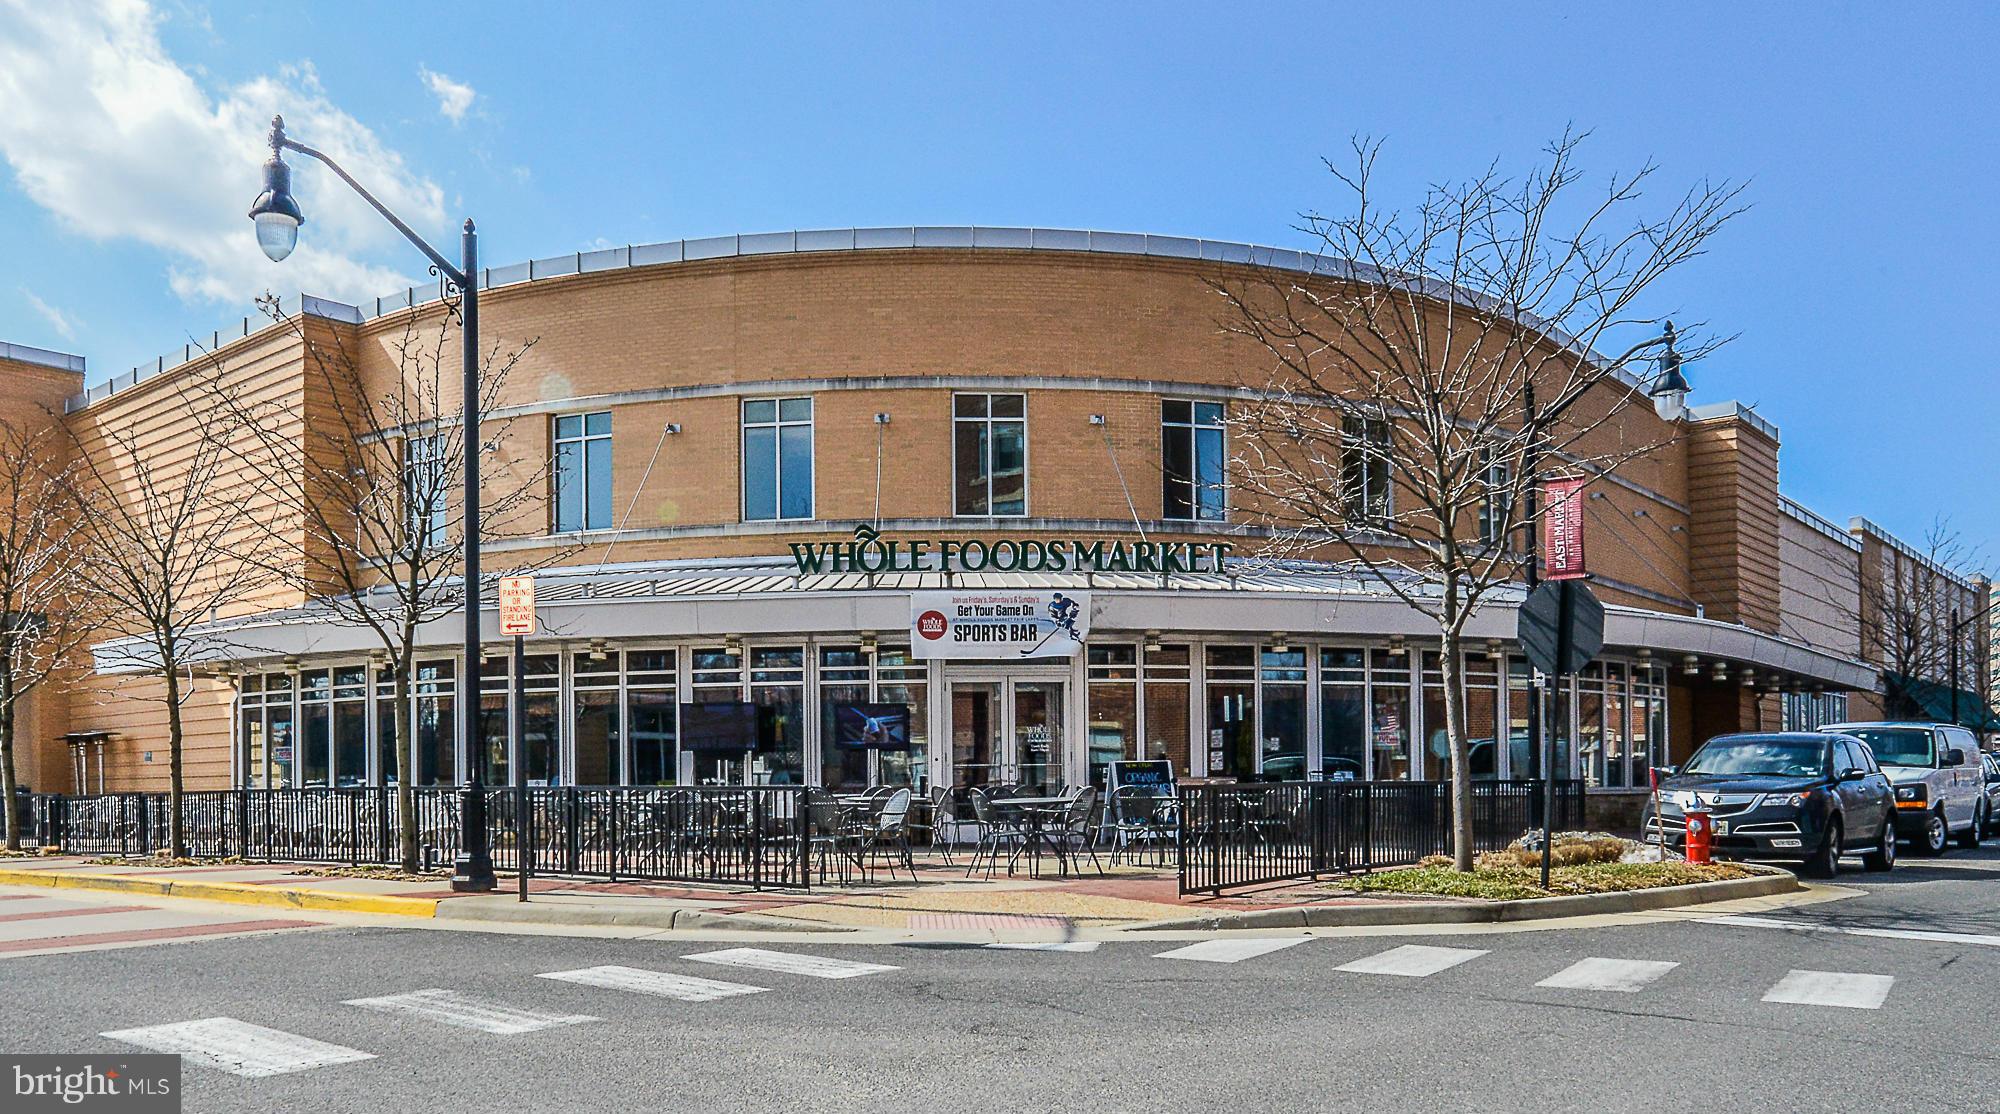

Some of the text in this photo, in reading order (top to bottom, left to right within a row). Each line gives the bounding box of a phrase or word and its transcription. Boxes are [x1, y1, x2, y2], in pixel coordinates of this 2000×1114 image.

[787, 535, 1234, 575] WHOLE FOODS MARKET
[1555, 539, 1567, 569] EAST
[503, 605, 531, 613] STANDING
[957, 605, 1034, 616] Get Your Game On
[515, 613, 531, 621] LANE
[953, 624, 1038, 642] SPORTS BAR
